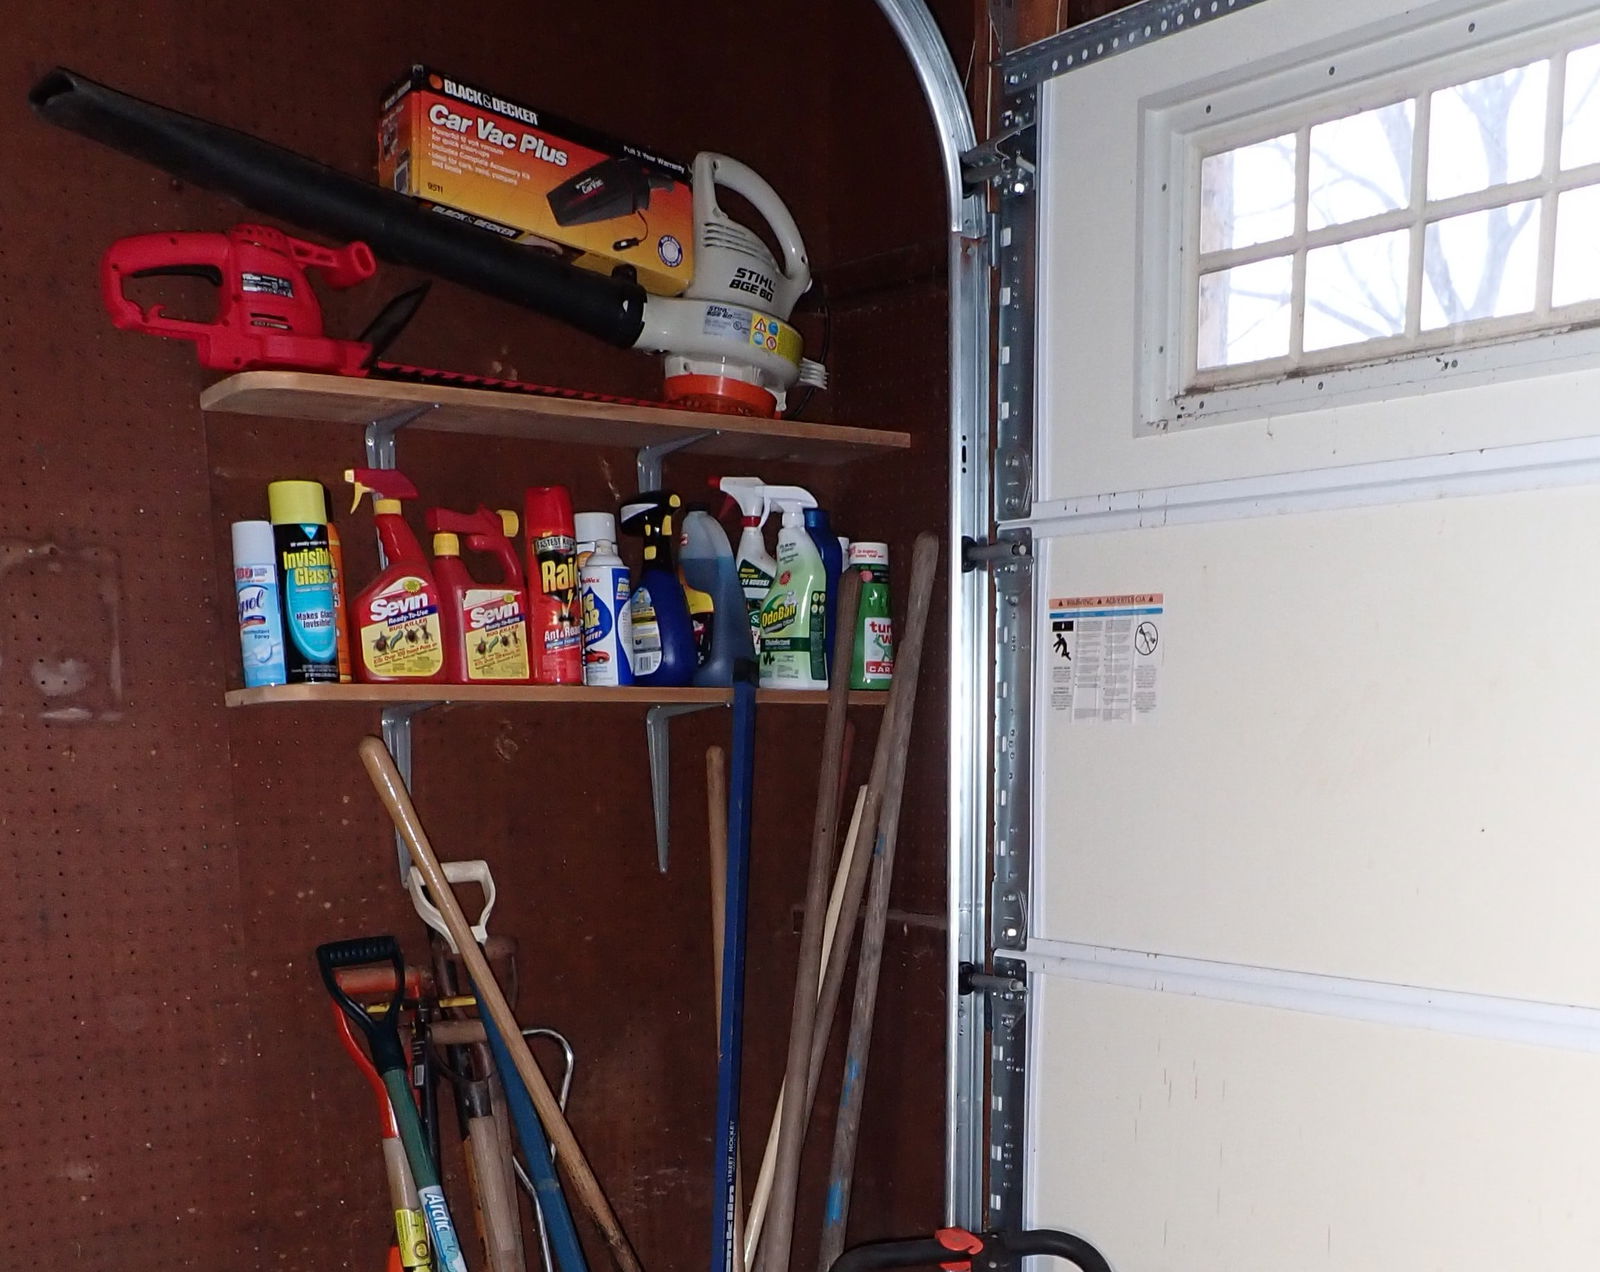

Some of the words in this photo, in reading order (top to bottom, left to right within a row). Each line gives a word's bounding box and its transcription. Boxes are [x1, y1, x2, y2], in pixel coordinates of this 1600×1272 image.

[444, 79, 539, 126] BLACK&DECKER
[429, 104, 473, 133] Car
[477, 117, 517, 149] Vac
[519, 133, 568, 167] Plus
[729, 278, 758, 295] BGE
[759, 289, 773, 303] 60
[735, 267, 775, 294] STIHL
[370, 593, 429, 622] Sevin
[388, 609, 429, 625] Ready-To-Use
[471, 602, 519, 629] Sevin
[761, 604, 797, 628] OdoBan
[727, 1156, 735, 1183] STREET
[425, 1192, 451, 1233] Arctic
